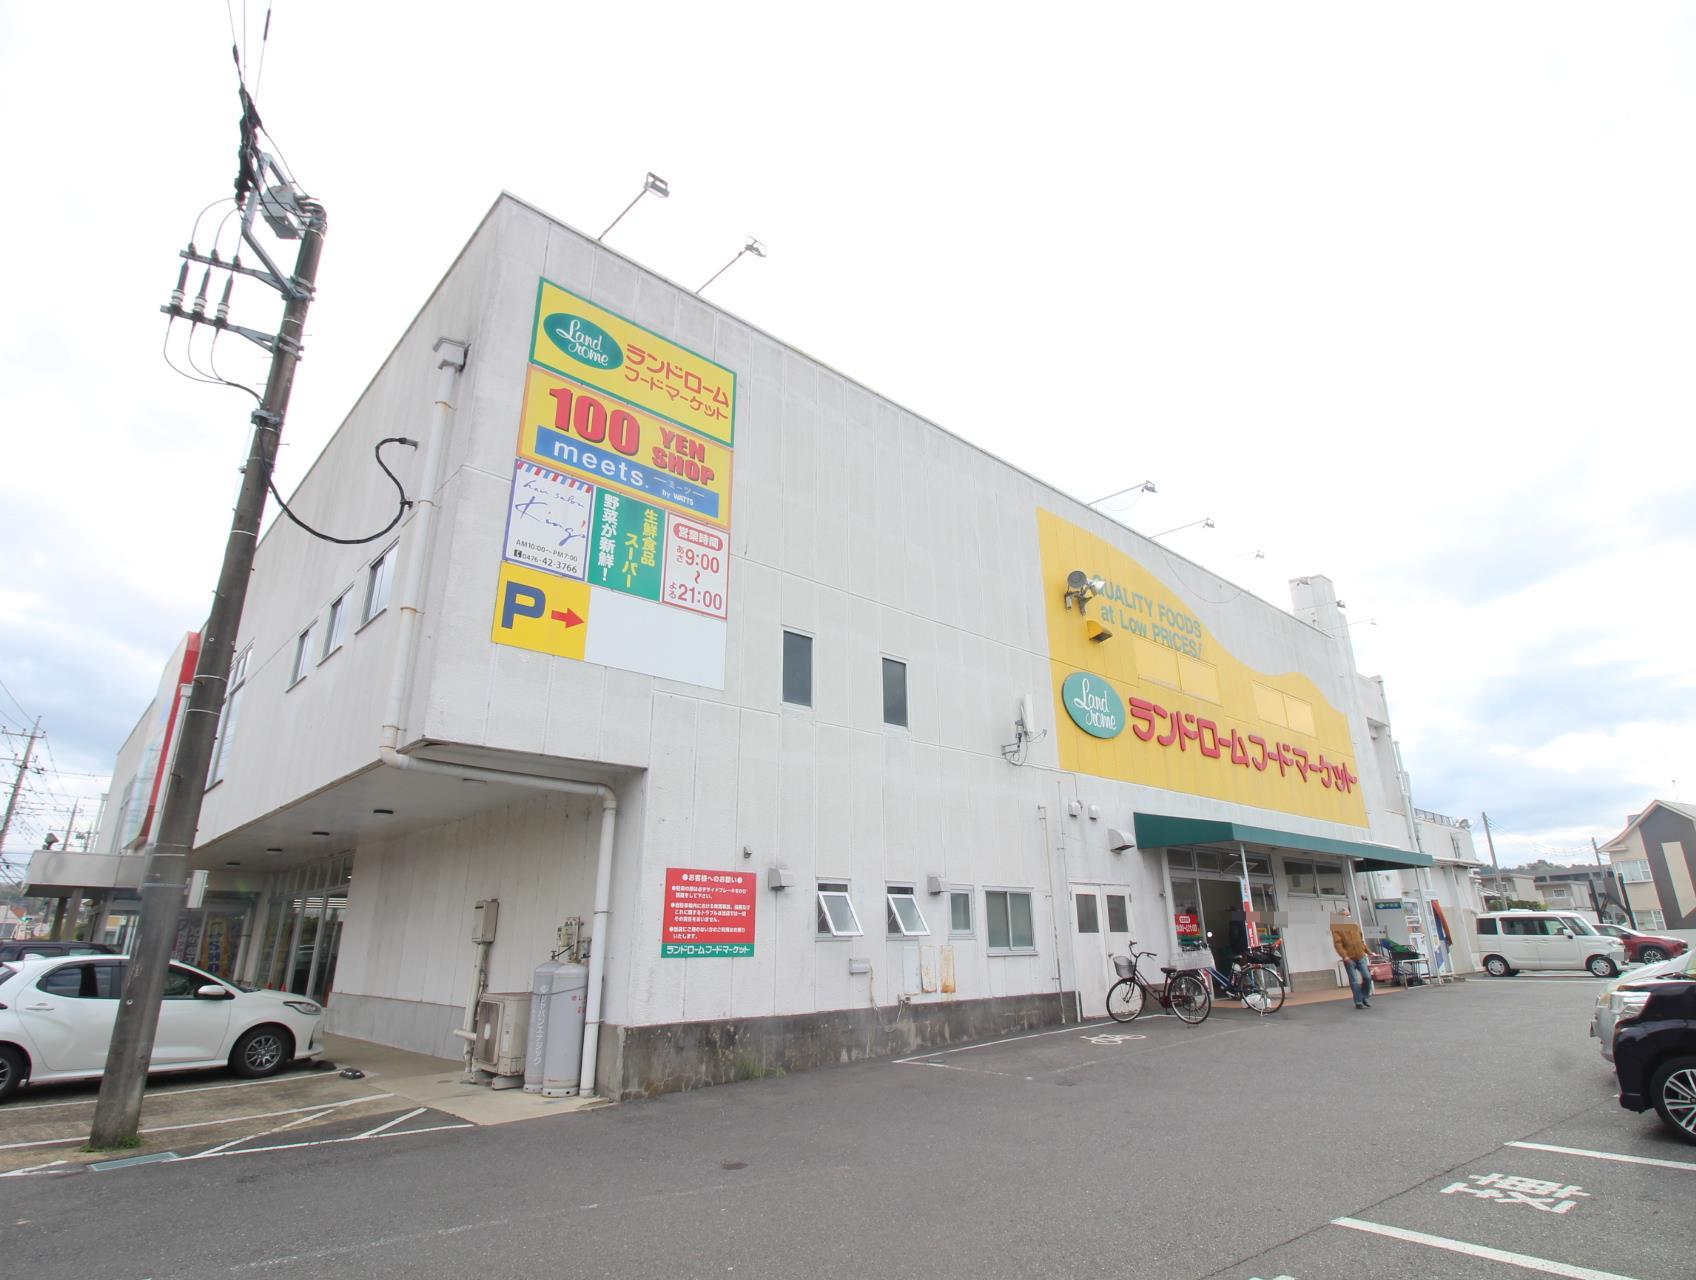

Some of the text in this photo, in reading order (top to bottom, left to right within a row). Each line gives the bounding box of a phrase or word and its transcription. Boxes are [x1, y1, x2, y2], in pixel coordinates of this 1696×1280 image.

[555, 319, 603, 353] Land
[624, 365, 729, 420] フードマーケット
[625, 343, 730, 408] ランドローム
[549, 387, 640, 456] 100
[659, 427, 706, 463] YEN
[553, 439, 649, 489] meets.
[652, 446, 715, 485] SHOP
[662, 489, 694, 506] by WATTS
[641, 508, 658, 567] 生鮮食品
[678, 525, 719, 551] 営業時間
[522, 552, 578, 574] 0476-42-3766
[622, 532, 639, 588] スーパー
[685, 549, 720, 574] 9:00
[501, 580, 547, 630] P
[678, 584, 723, 611] 21:00
[1101, 605, 1115, 625] at
[1158, 602, 1202, 639] FOODS
[1073, 678, 1110, 713] Land
